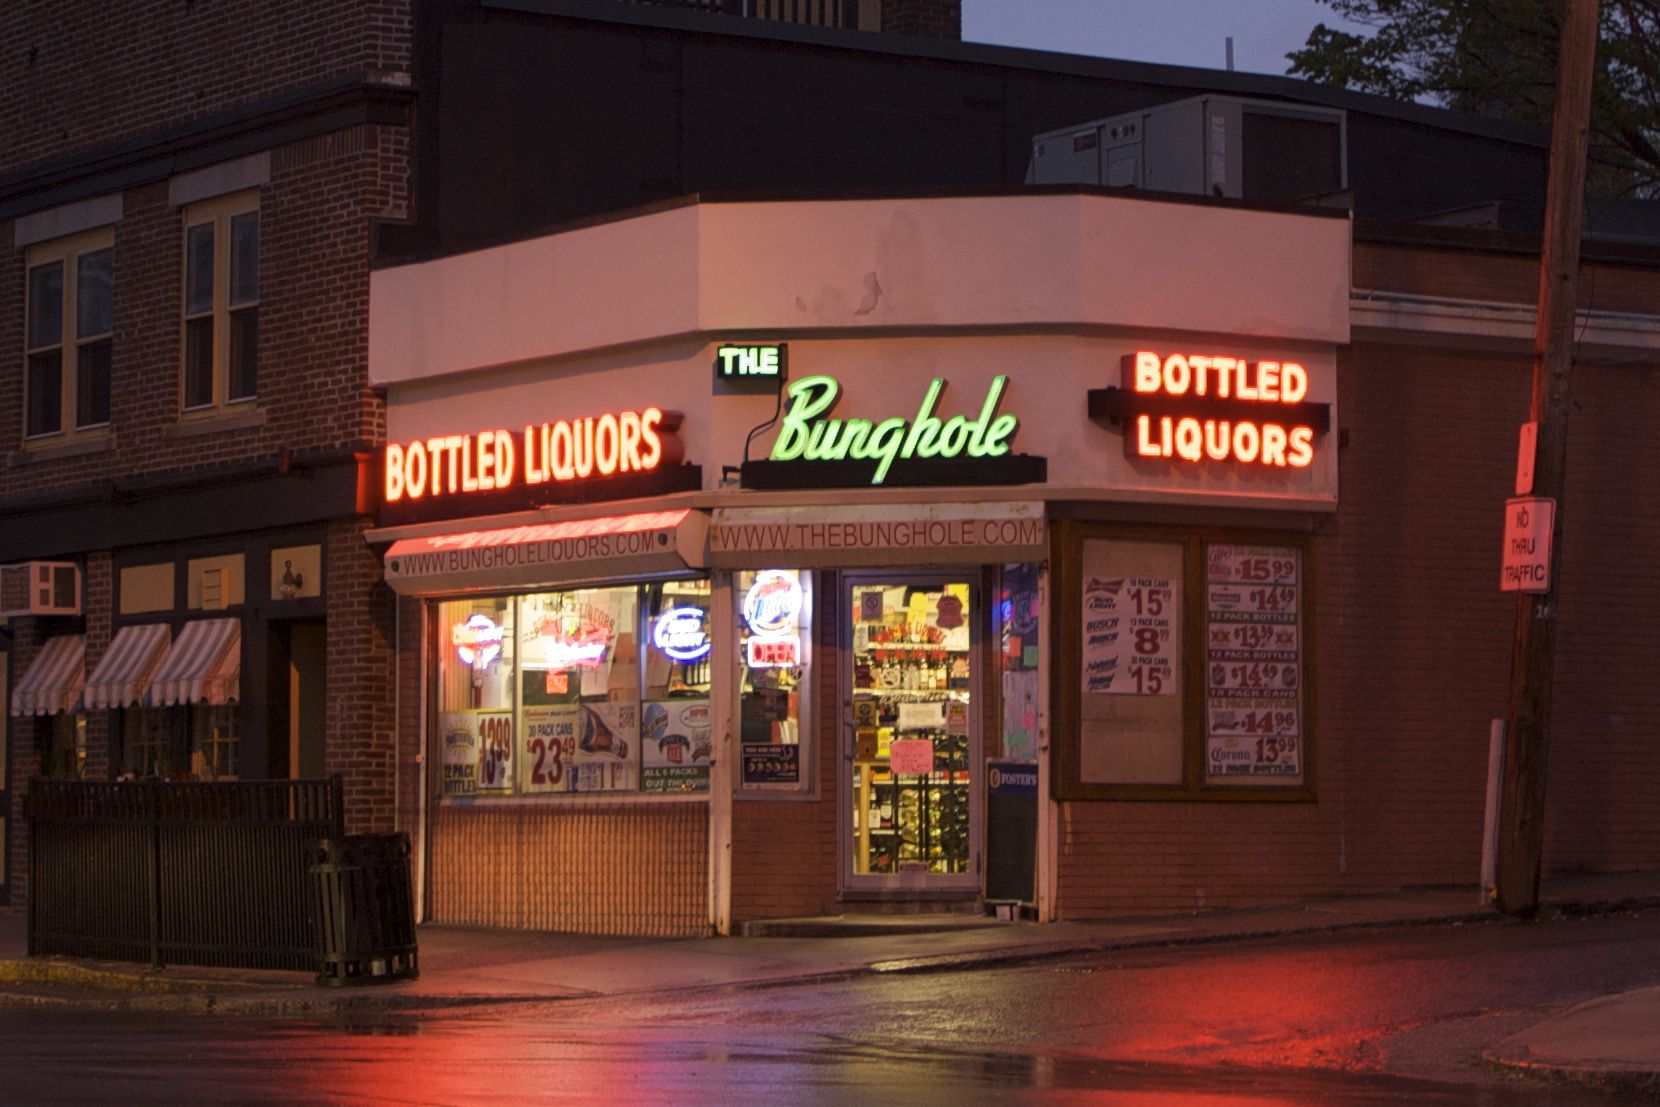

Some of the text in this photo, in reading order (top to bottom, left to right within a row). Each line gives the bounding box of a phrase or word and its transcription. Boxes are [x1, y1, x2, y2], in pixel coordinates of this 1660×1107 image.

[719, 347, 779, 375] THE
[1136, 351, 1307, 403] BOTTLED
[769, 374, 1017, 484] Bunghole
[1138, 415, 1313, 467] LIQUORS
[386, 407, 662, 501] BOTTLED LIQUORS
[1516, 508, 1529, 529] NO
[719, 519, 1039, 550] WWW.THEBUNGHOLE.COM
[403, 531, 654, 575] WWW.BUNGHOLELIQUORS.COM
[1512, 538, 1536, 555] THRU
[1505, 564, 1545, 583] TRAFFIC
[1224, 612, 1249, 620] PACK
[1253, 613, 1296, 621] BOTTLES
[1253, 651, 1296, 659] BOTTLES
[1228, 689, 1260, 697] PACK
[537, 724, 555, 737] PACK
[556, 723, 573, 736] CANS
[1211, 747, 1250, 762] Corona
